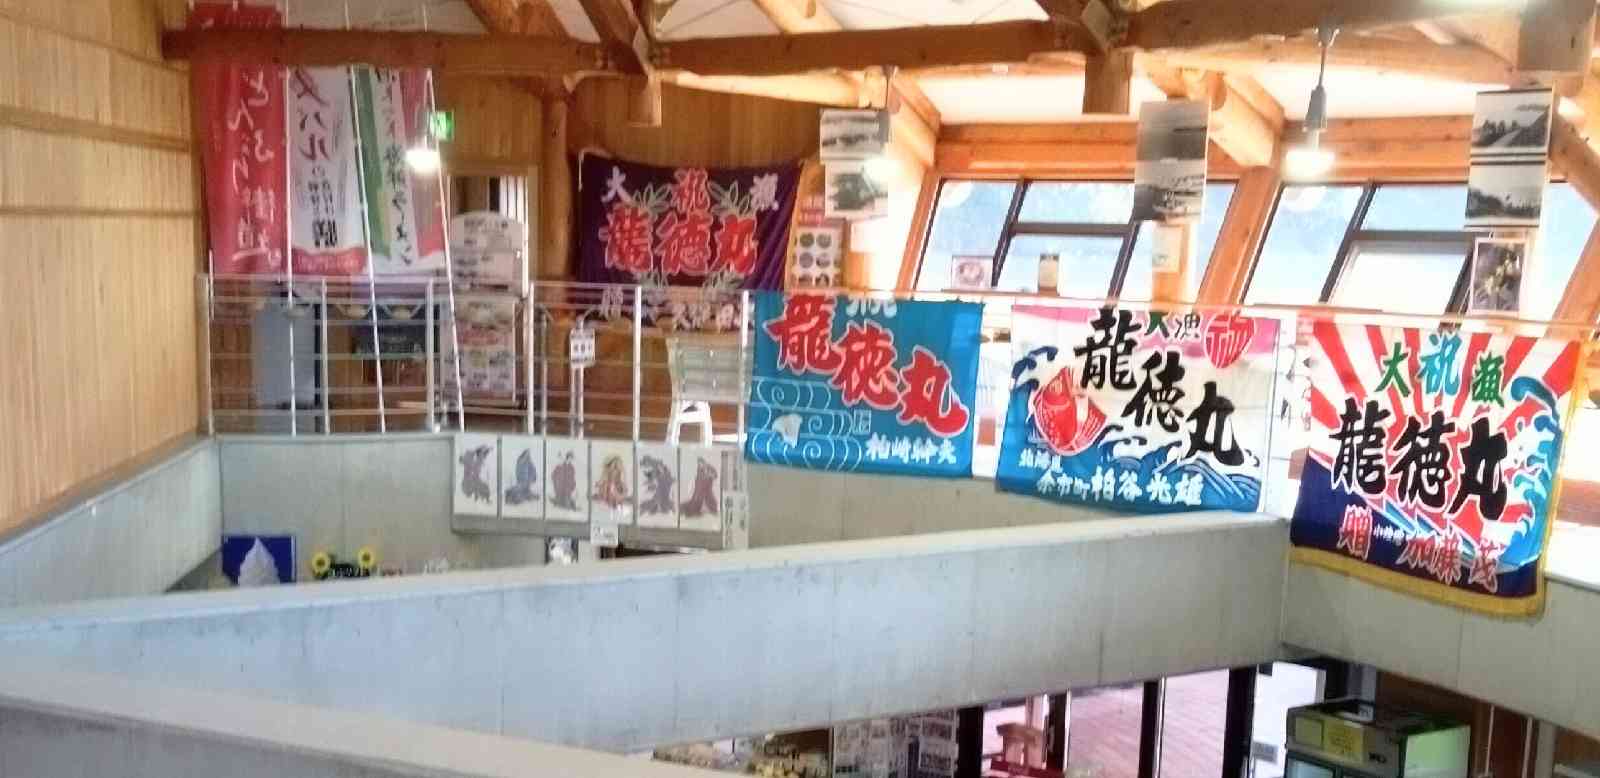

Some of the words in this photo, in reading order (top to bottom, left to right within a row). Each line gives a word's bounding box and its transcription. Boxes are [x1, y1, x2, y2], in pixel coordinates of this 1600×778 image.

[598, 203, 759, 276] 龍徳丸
[764, 293, 970, 438] 龍徳丸
[1073, 306, 1245, 467] 龍徳丸
[1329, 397, 1509, 521] 龍徳丸
